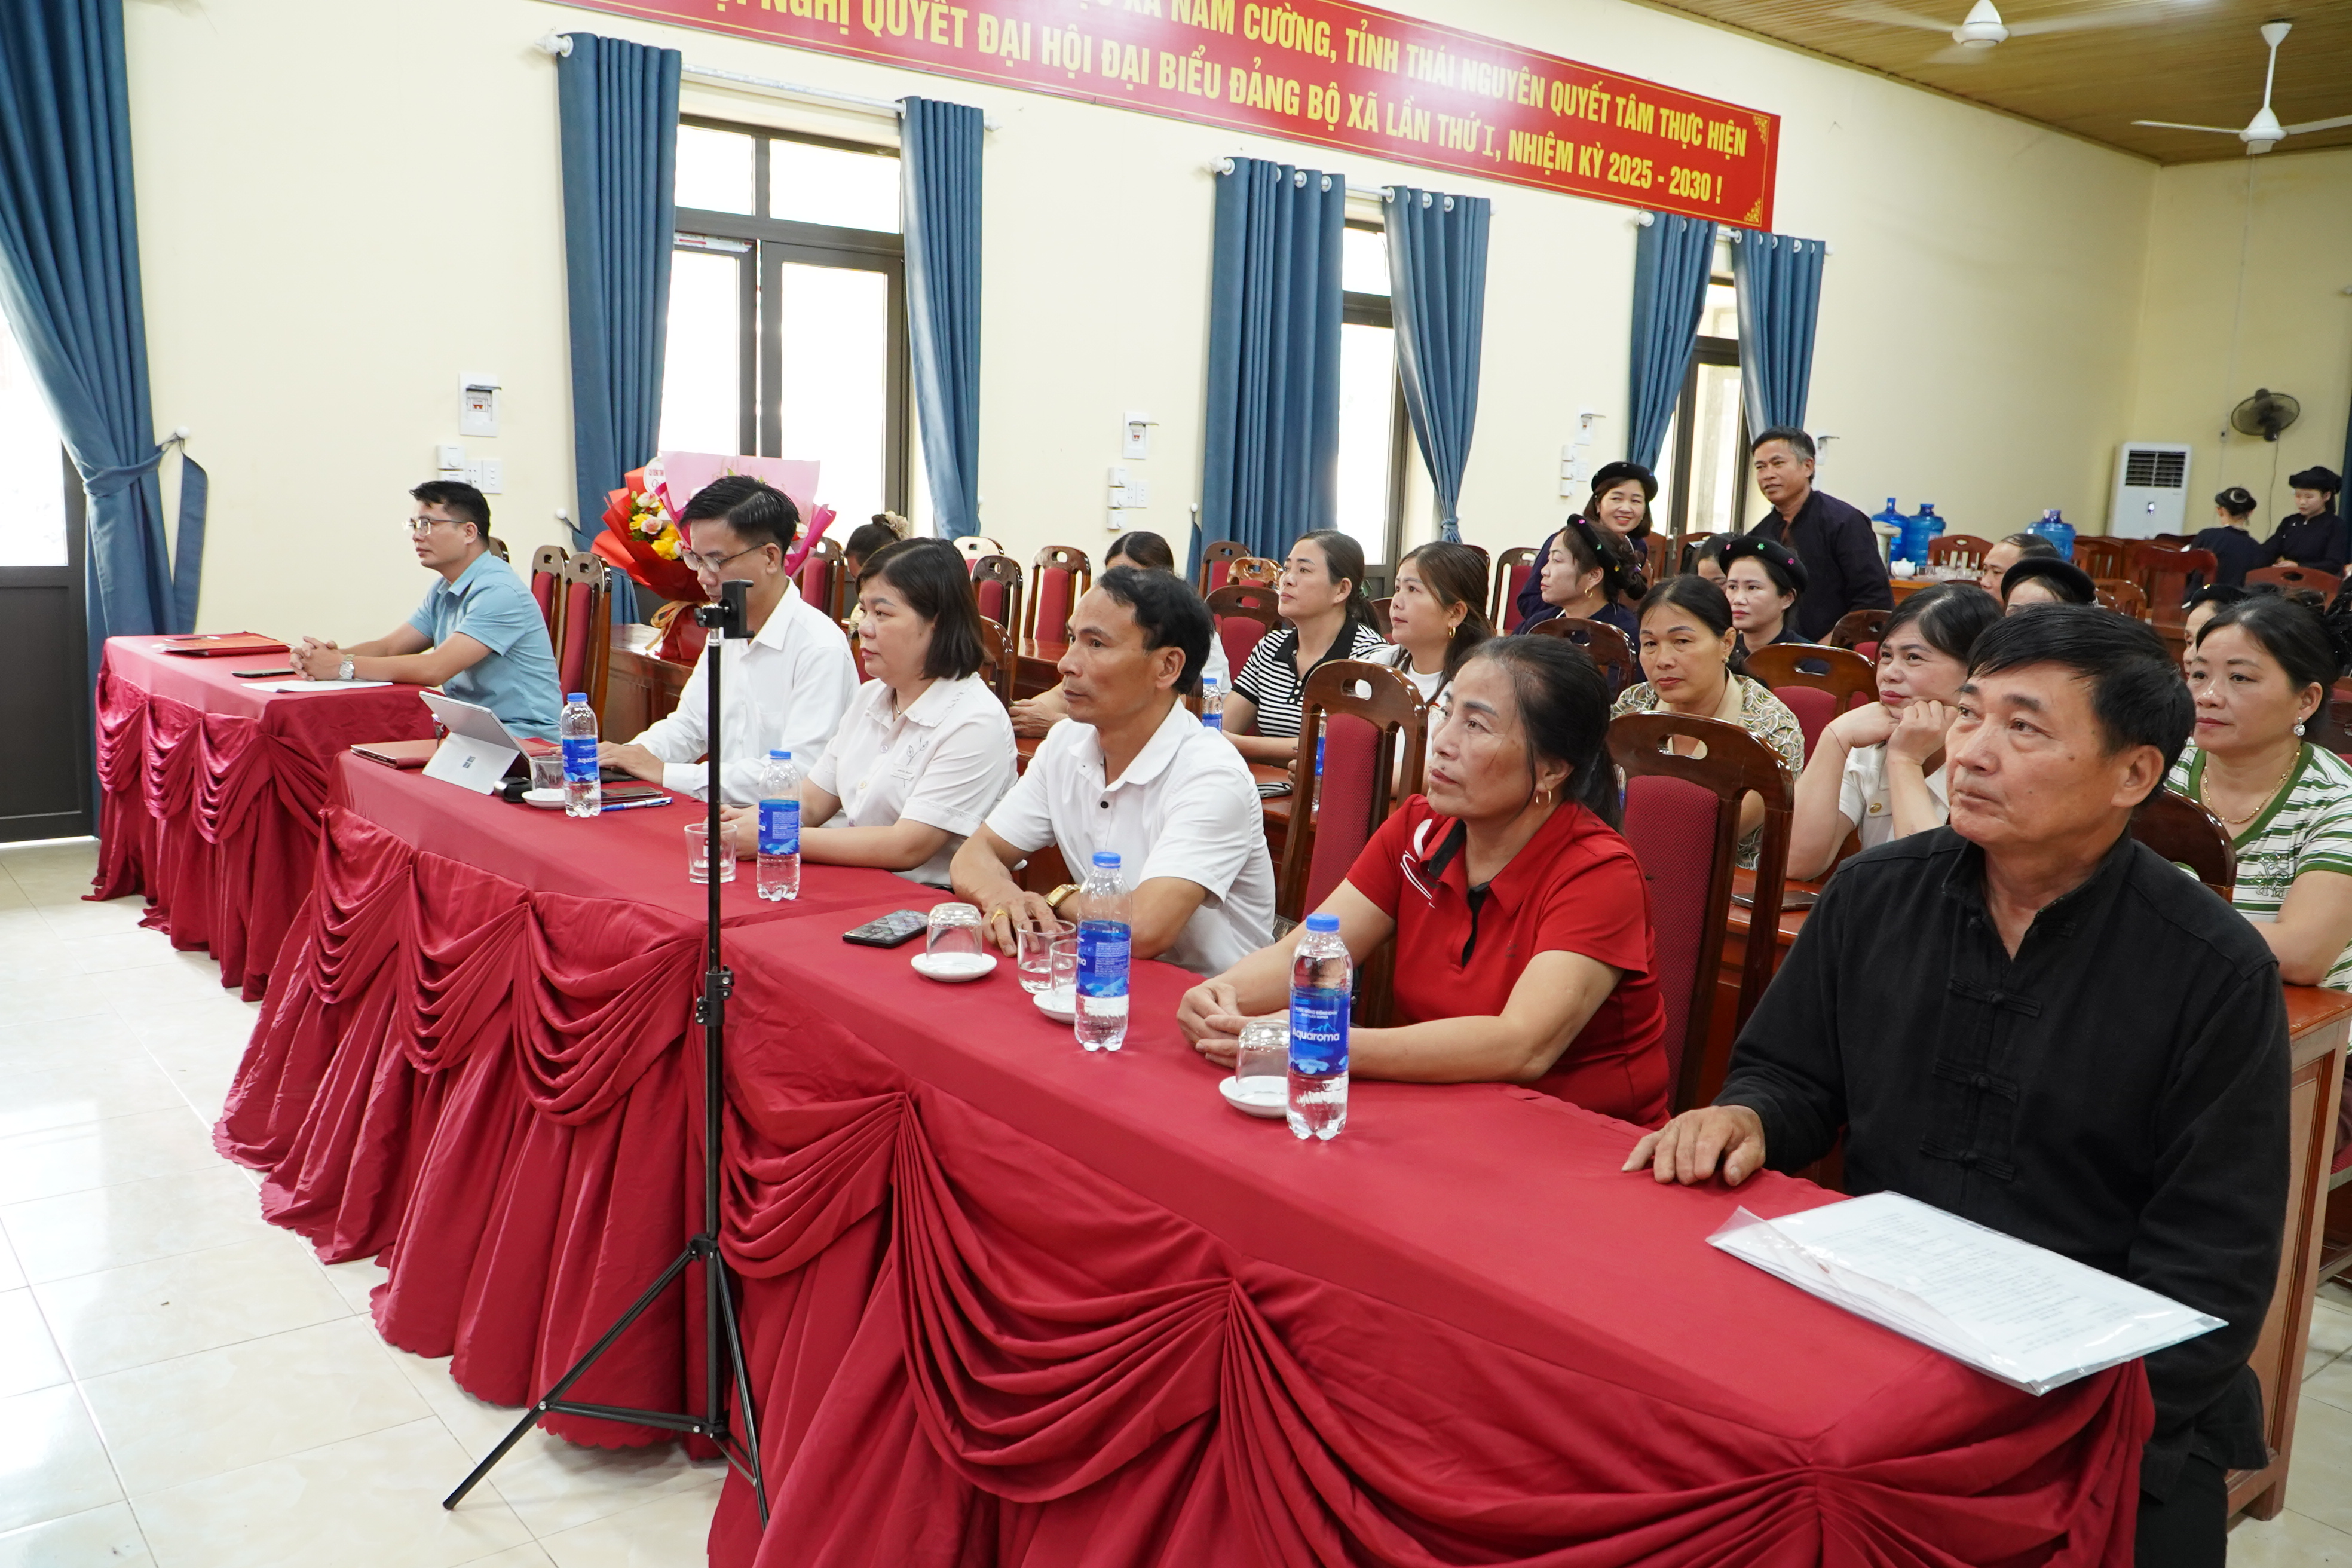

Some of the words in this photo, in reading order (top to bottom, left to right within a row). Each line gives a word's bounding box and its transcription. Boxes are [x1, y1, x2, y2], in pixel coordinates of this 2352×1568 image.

[977, 12, 1031, 68] ĐẠI
[1041, 23, 1092, 79] HỘI
[1101, 38, 1150, 91] ĐẠI
[1159, 44, 1222, 99] BIỂU
[1229, 56, 1301, 116] ĐẢNG
[1307, 81, 1341, 131] BỘ
[1346, 90, 1379, 133] XÃ
[1385, 94, 1431, 143] LẦN
[1437, 111, 1482, 152] THỨ
[1482, 124, 1502, 163] I,
[1507, 130, 1575, 176] NHIỆM
[1578, 142, 1605, 179] KỲ
[1607, 152, 1653, 189] 2025
[1668, 166, 1711, 201] 2030
[1716, 176, 1722, 204] !
[1244, 2, 1337, 63] CƯỜNG,
[1346, 19, 1400, 75] TỈNH
[1406, 44, 1456, 87] THÁI
[1461, 58, 1546, 109] NGUYÊN
[1550, 80, 1611, 124] QUYẾT
[1615, 93, 1655, 134] TÂM
[1659, 107, 1704, 149] THỰC
[1707, 119, 1747, 160] HIỆN
[1292, 1027, 1340, 1042] Aquaroma
